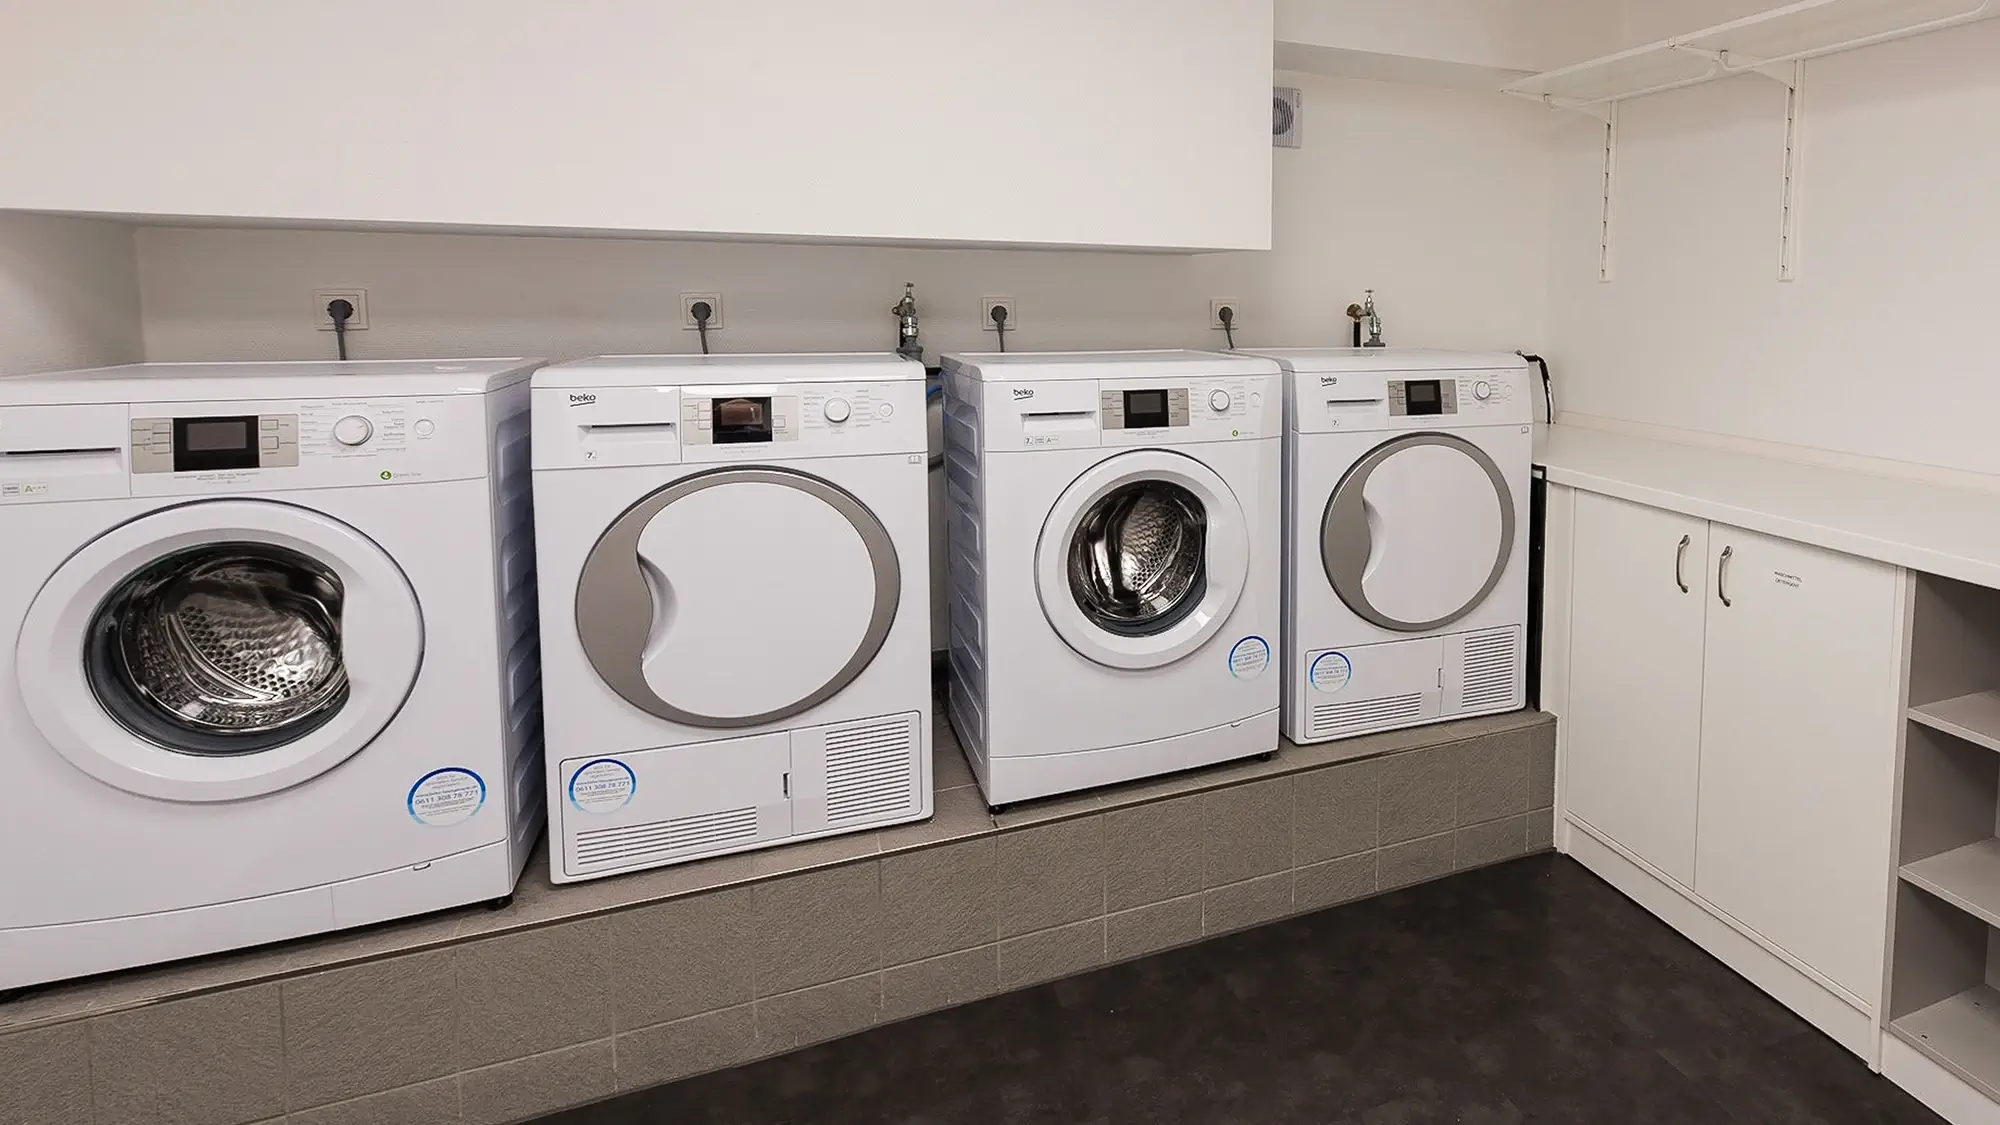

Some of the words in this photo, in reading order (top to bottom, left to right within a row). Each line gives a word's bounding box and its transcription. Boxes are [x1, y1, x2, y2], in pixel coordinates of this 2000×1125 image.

[1013, 388, 1034, 397] beko
[569, 393, 596, 402] beko
[415, 796, 434, 805] 0611
[453, 792, 463, 800] 78
[464, 789, 478, 798] 771
